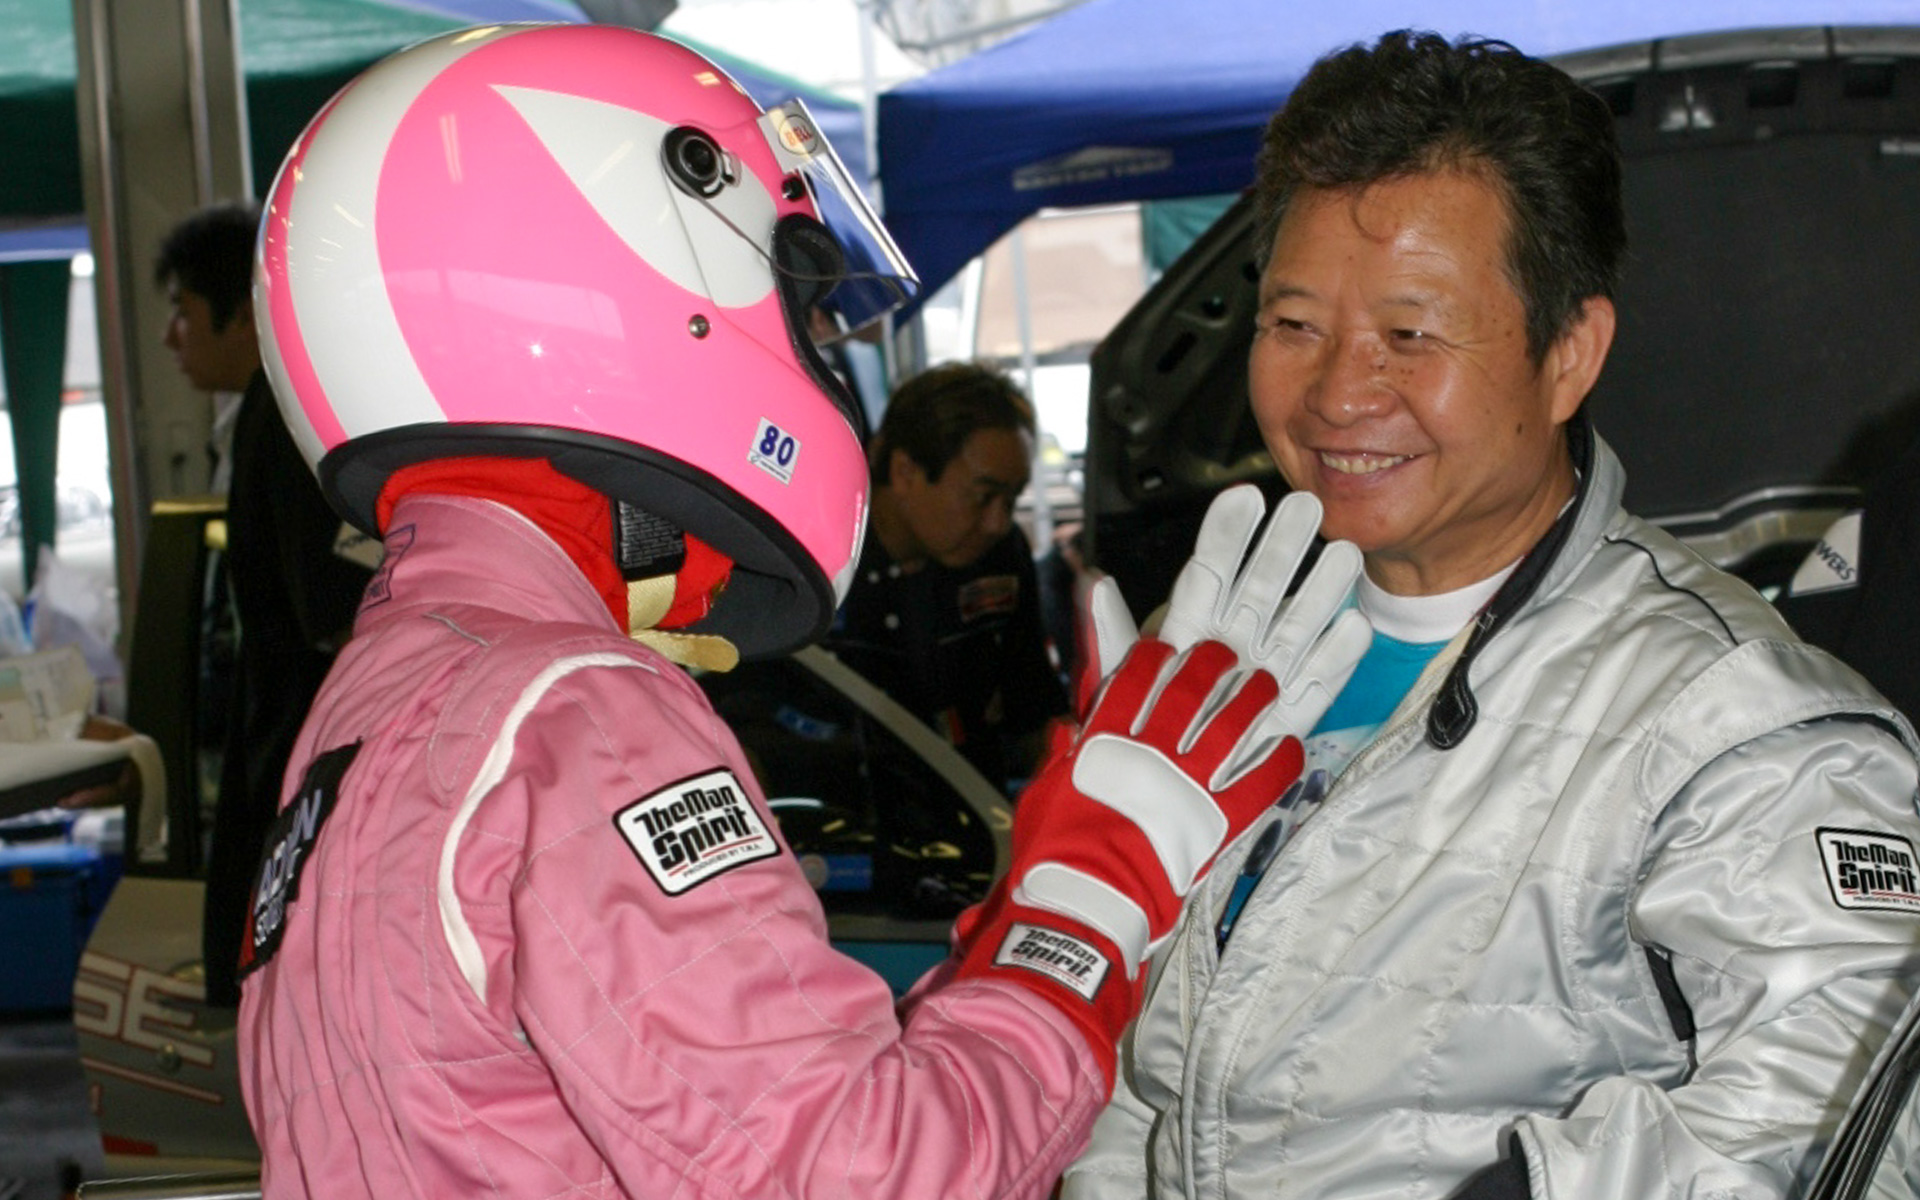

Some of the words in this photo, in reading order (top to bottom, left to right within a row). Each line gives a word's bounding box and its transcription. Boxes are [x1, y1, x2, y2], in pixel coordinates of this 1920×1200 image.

[759, 425, 795, 467] 80
[652, 806, 752, 871] Spirit
[1838, 862, 1917, 895] Spirit
[1011, 940, 1094, 977] Spirit
